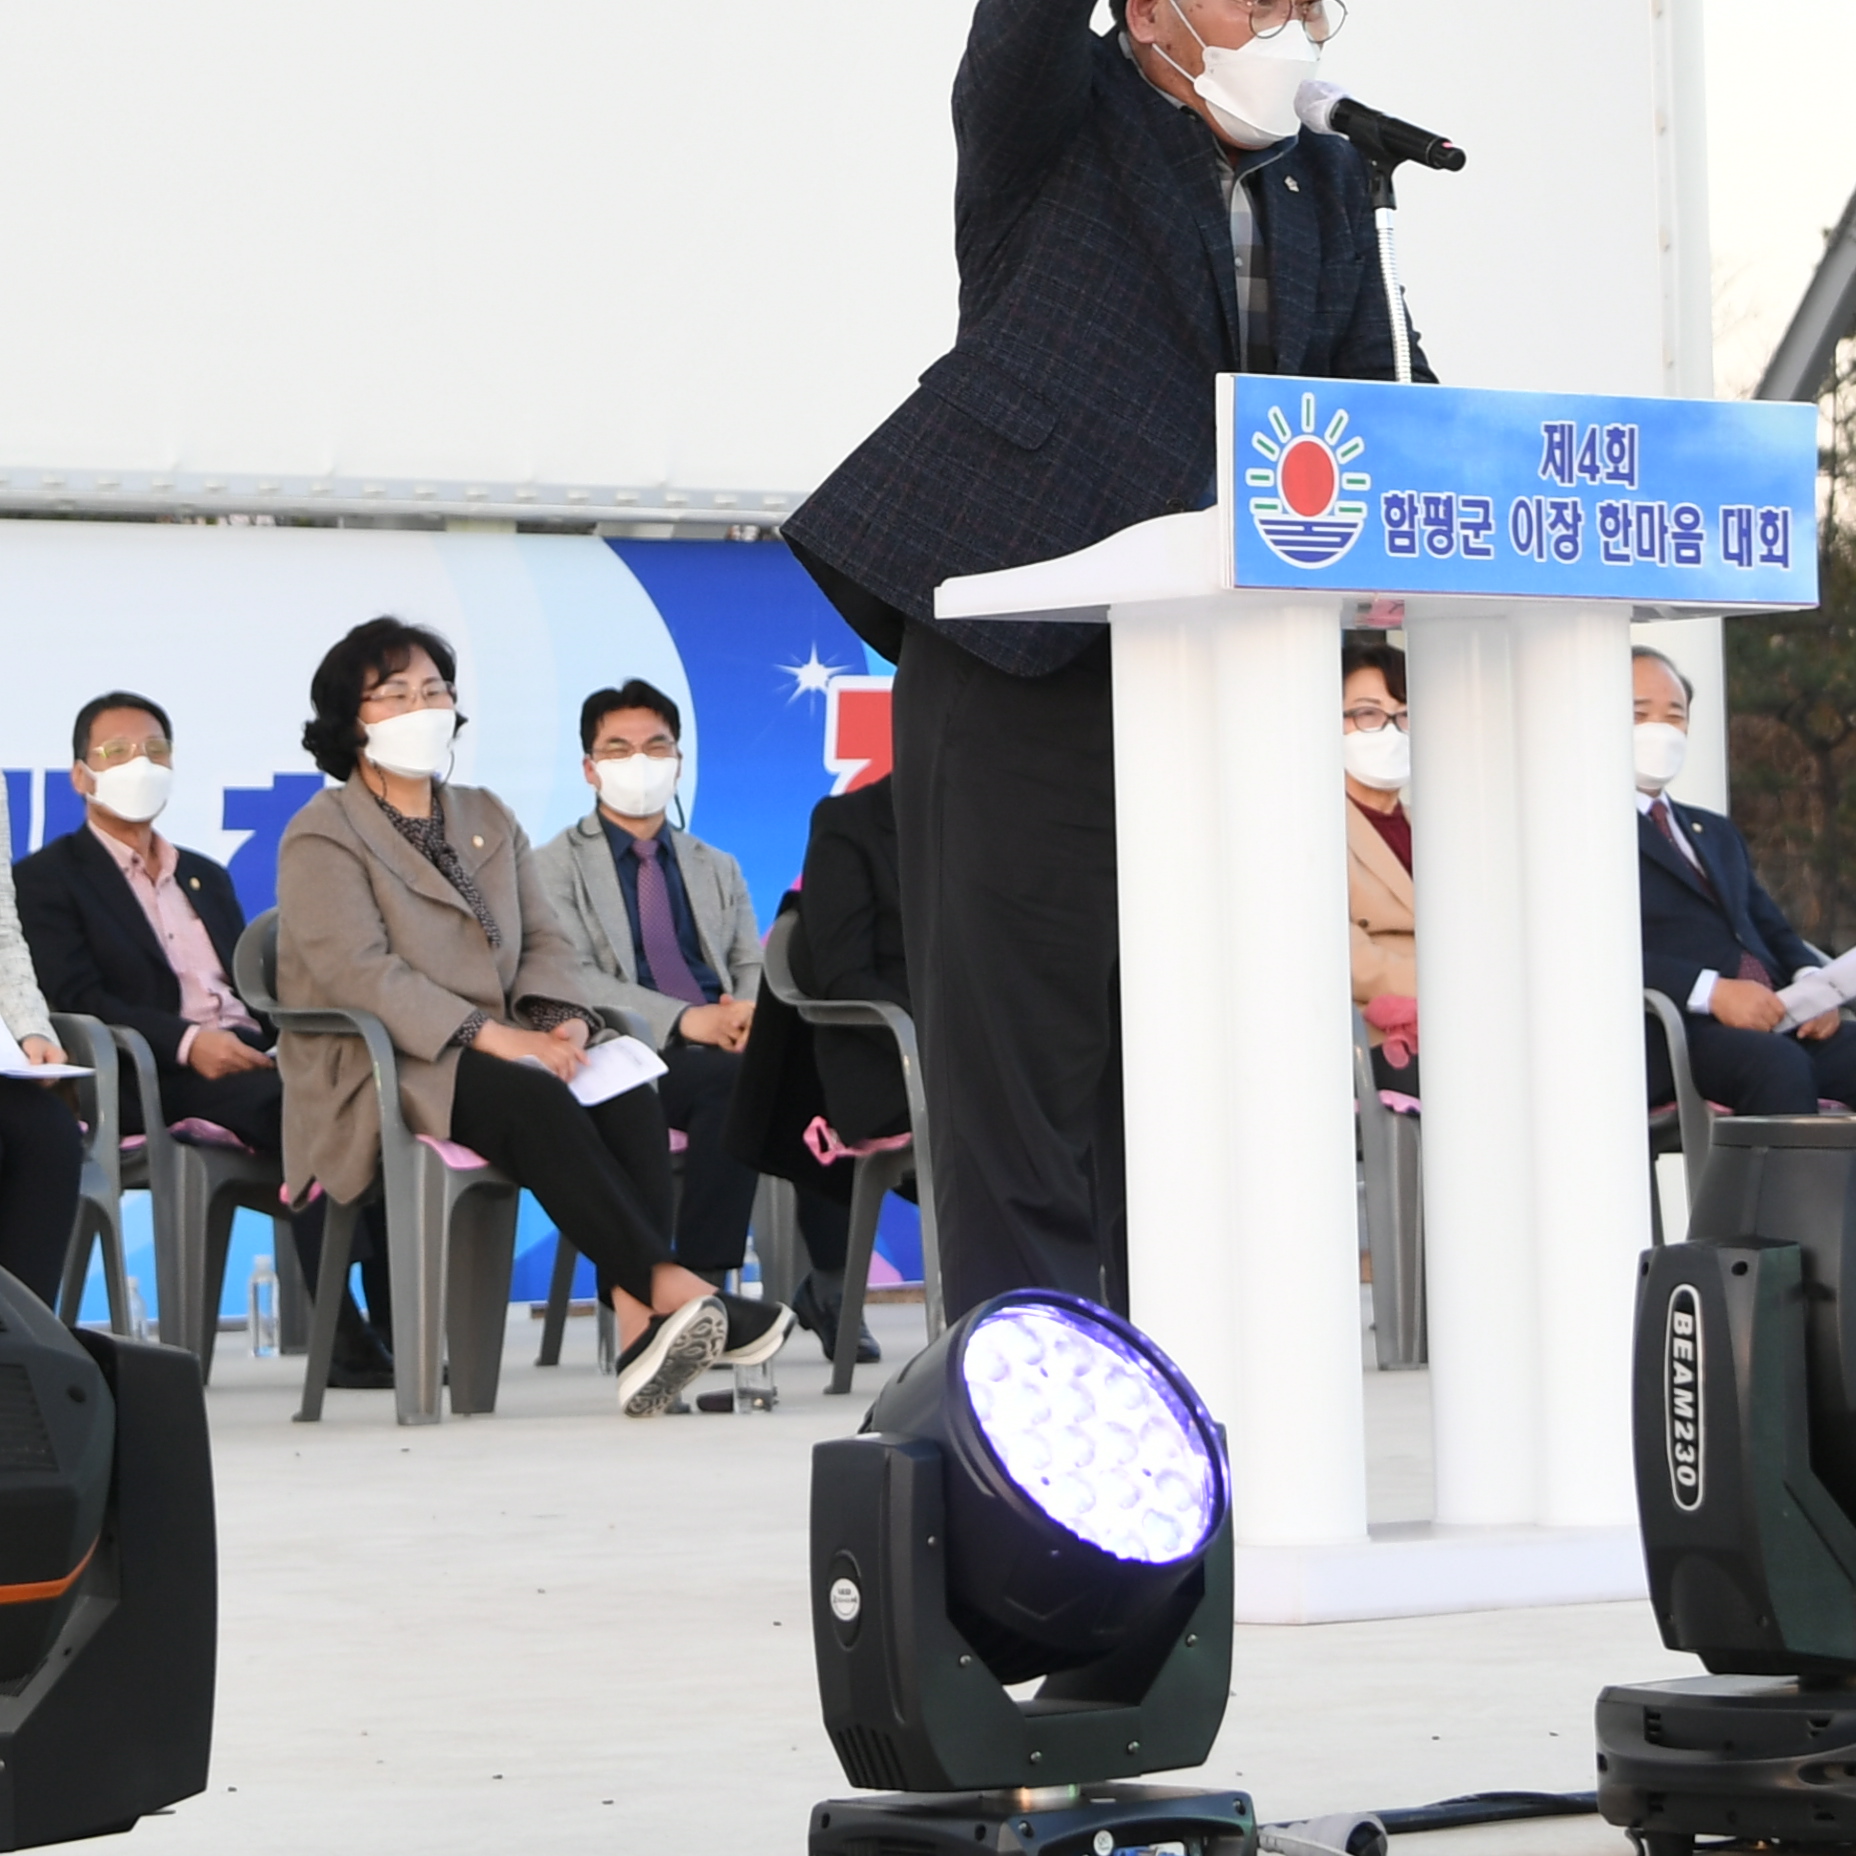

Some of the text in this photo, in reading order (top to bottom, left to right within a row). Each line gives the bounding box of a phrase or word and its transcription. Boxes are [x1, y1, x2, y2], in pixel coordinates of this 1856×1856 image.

[1541, 421, 1637, 488] 제4회
[1383, 492, 1792, 570] 함평군 이장 한마음 대회
[1672, 1310, 1696, 1487] BEAM230
